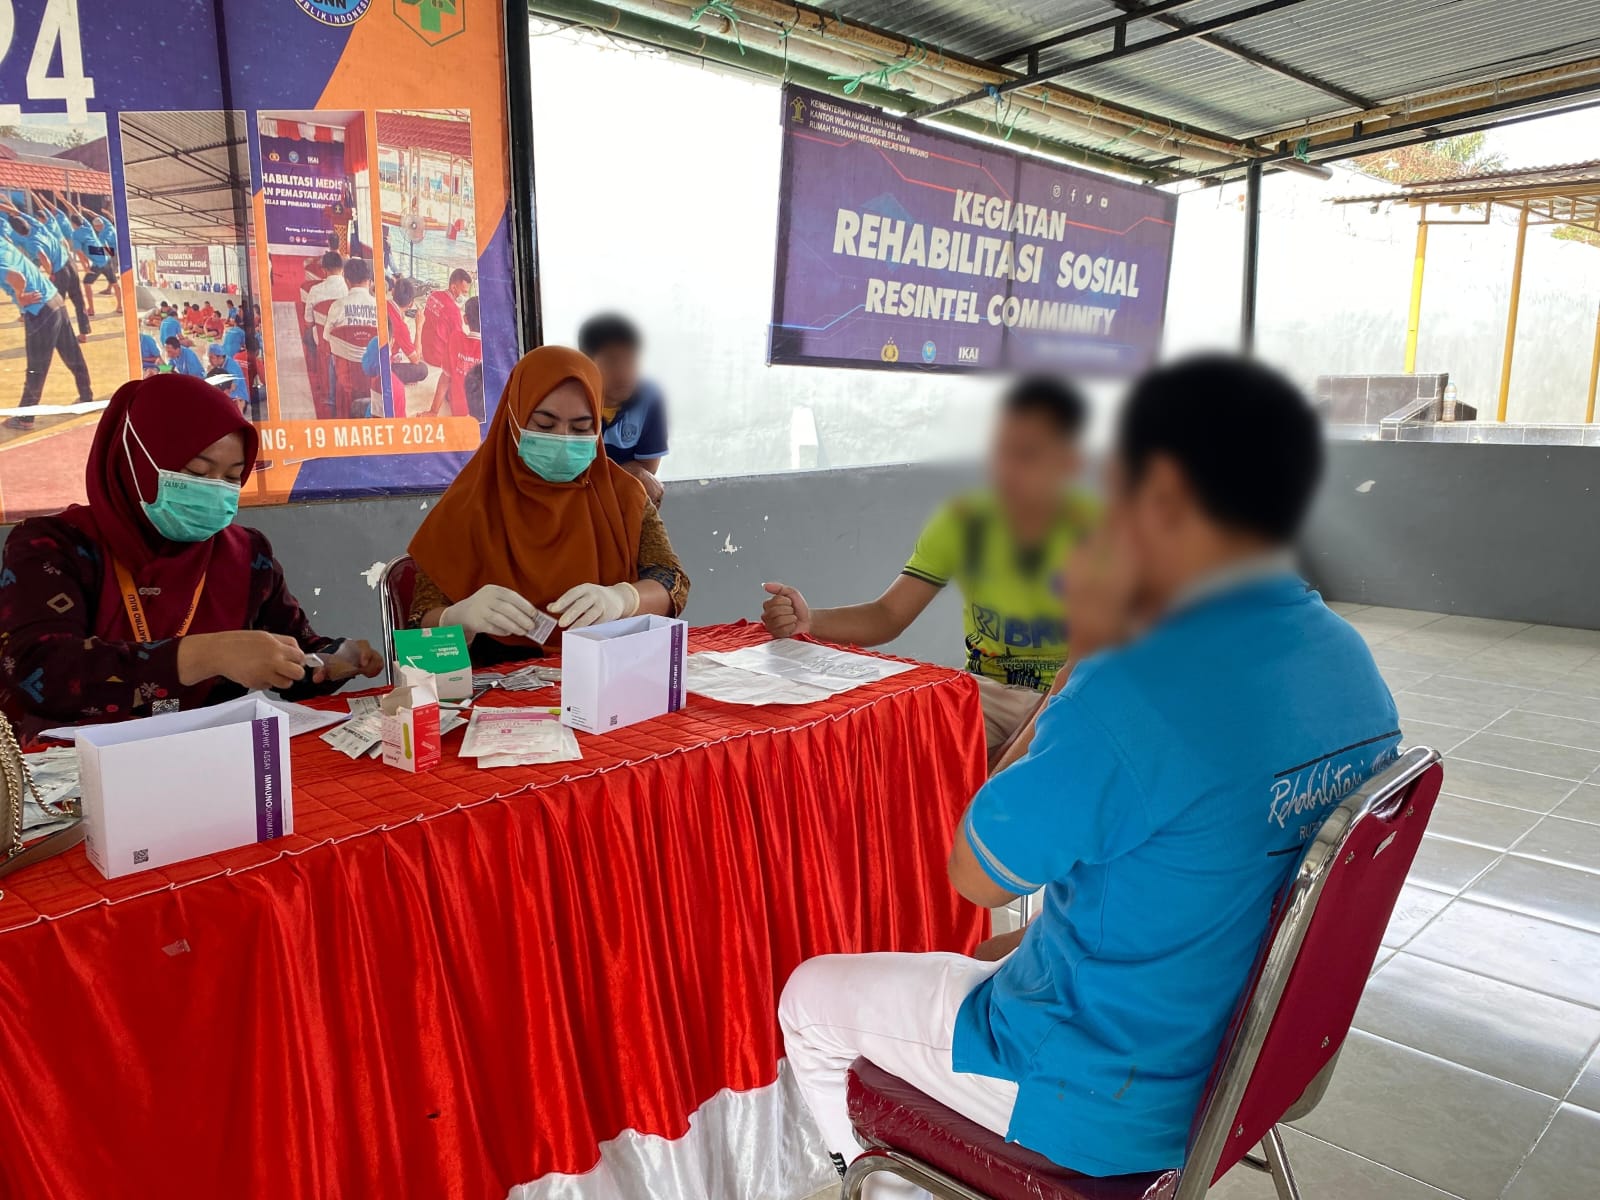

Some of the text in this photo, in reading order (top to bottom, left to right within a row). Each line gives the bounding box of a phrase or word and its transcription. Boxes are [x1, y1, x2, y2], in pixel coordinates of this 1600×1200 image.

[810, 99, 851, 117] KEMENTERIAN
[809, 121, 831, 134] RUMAH
[831, 126, 858, 140] TAHANAN
[858, 133, 882, 147] NEGARA
[881, 138, 899, 152] KELAS
[810, 110, 911, 144] KANTOR WILAYAH SULAWESI SELATAN
[275, 188, 342, 201] PEMASYARAKATA
[953, 189, 1067, 242] KEGIATAN
[832, 208, 1139, 298] REHABILITASI SOSIAL
[864, 278, 1116, 336] RESINTEL COMMUNITY
[957, 346, 980, 361] IKAI
[304, 427, 326, 448] 19
[334, 424, 394, 447] MARET
[402, 423, 445, 444] 2024
